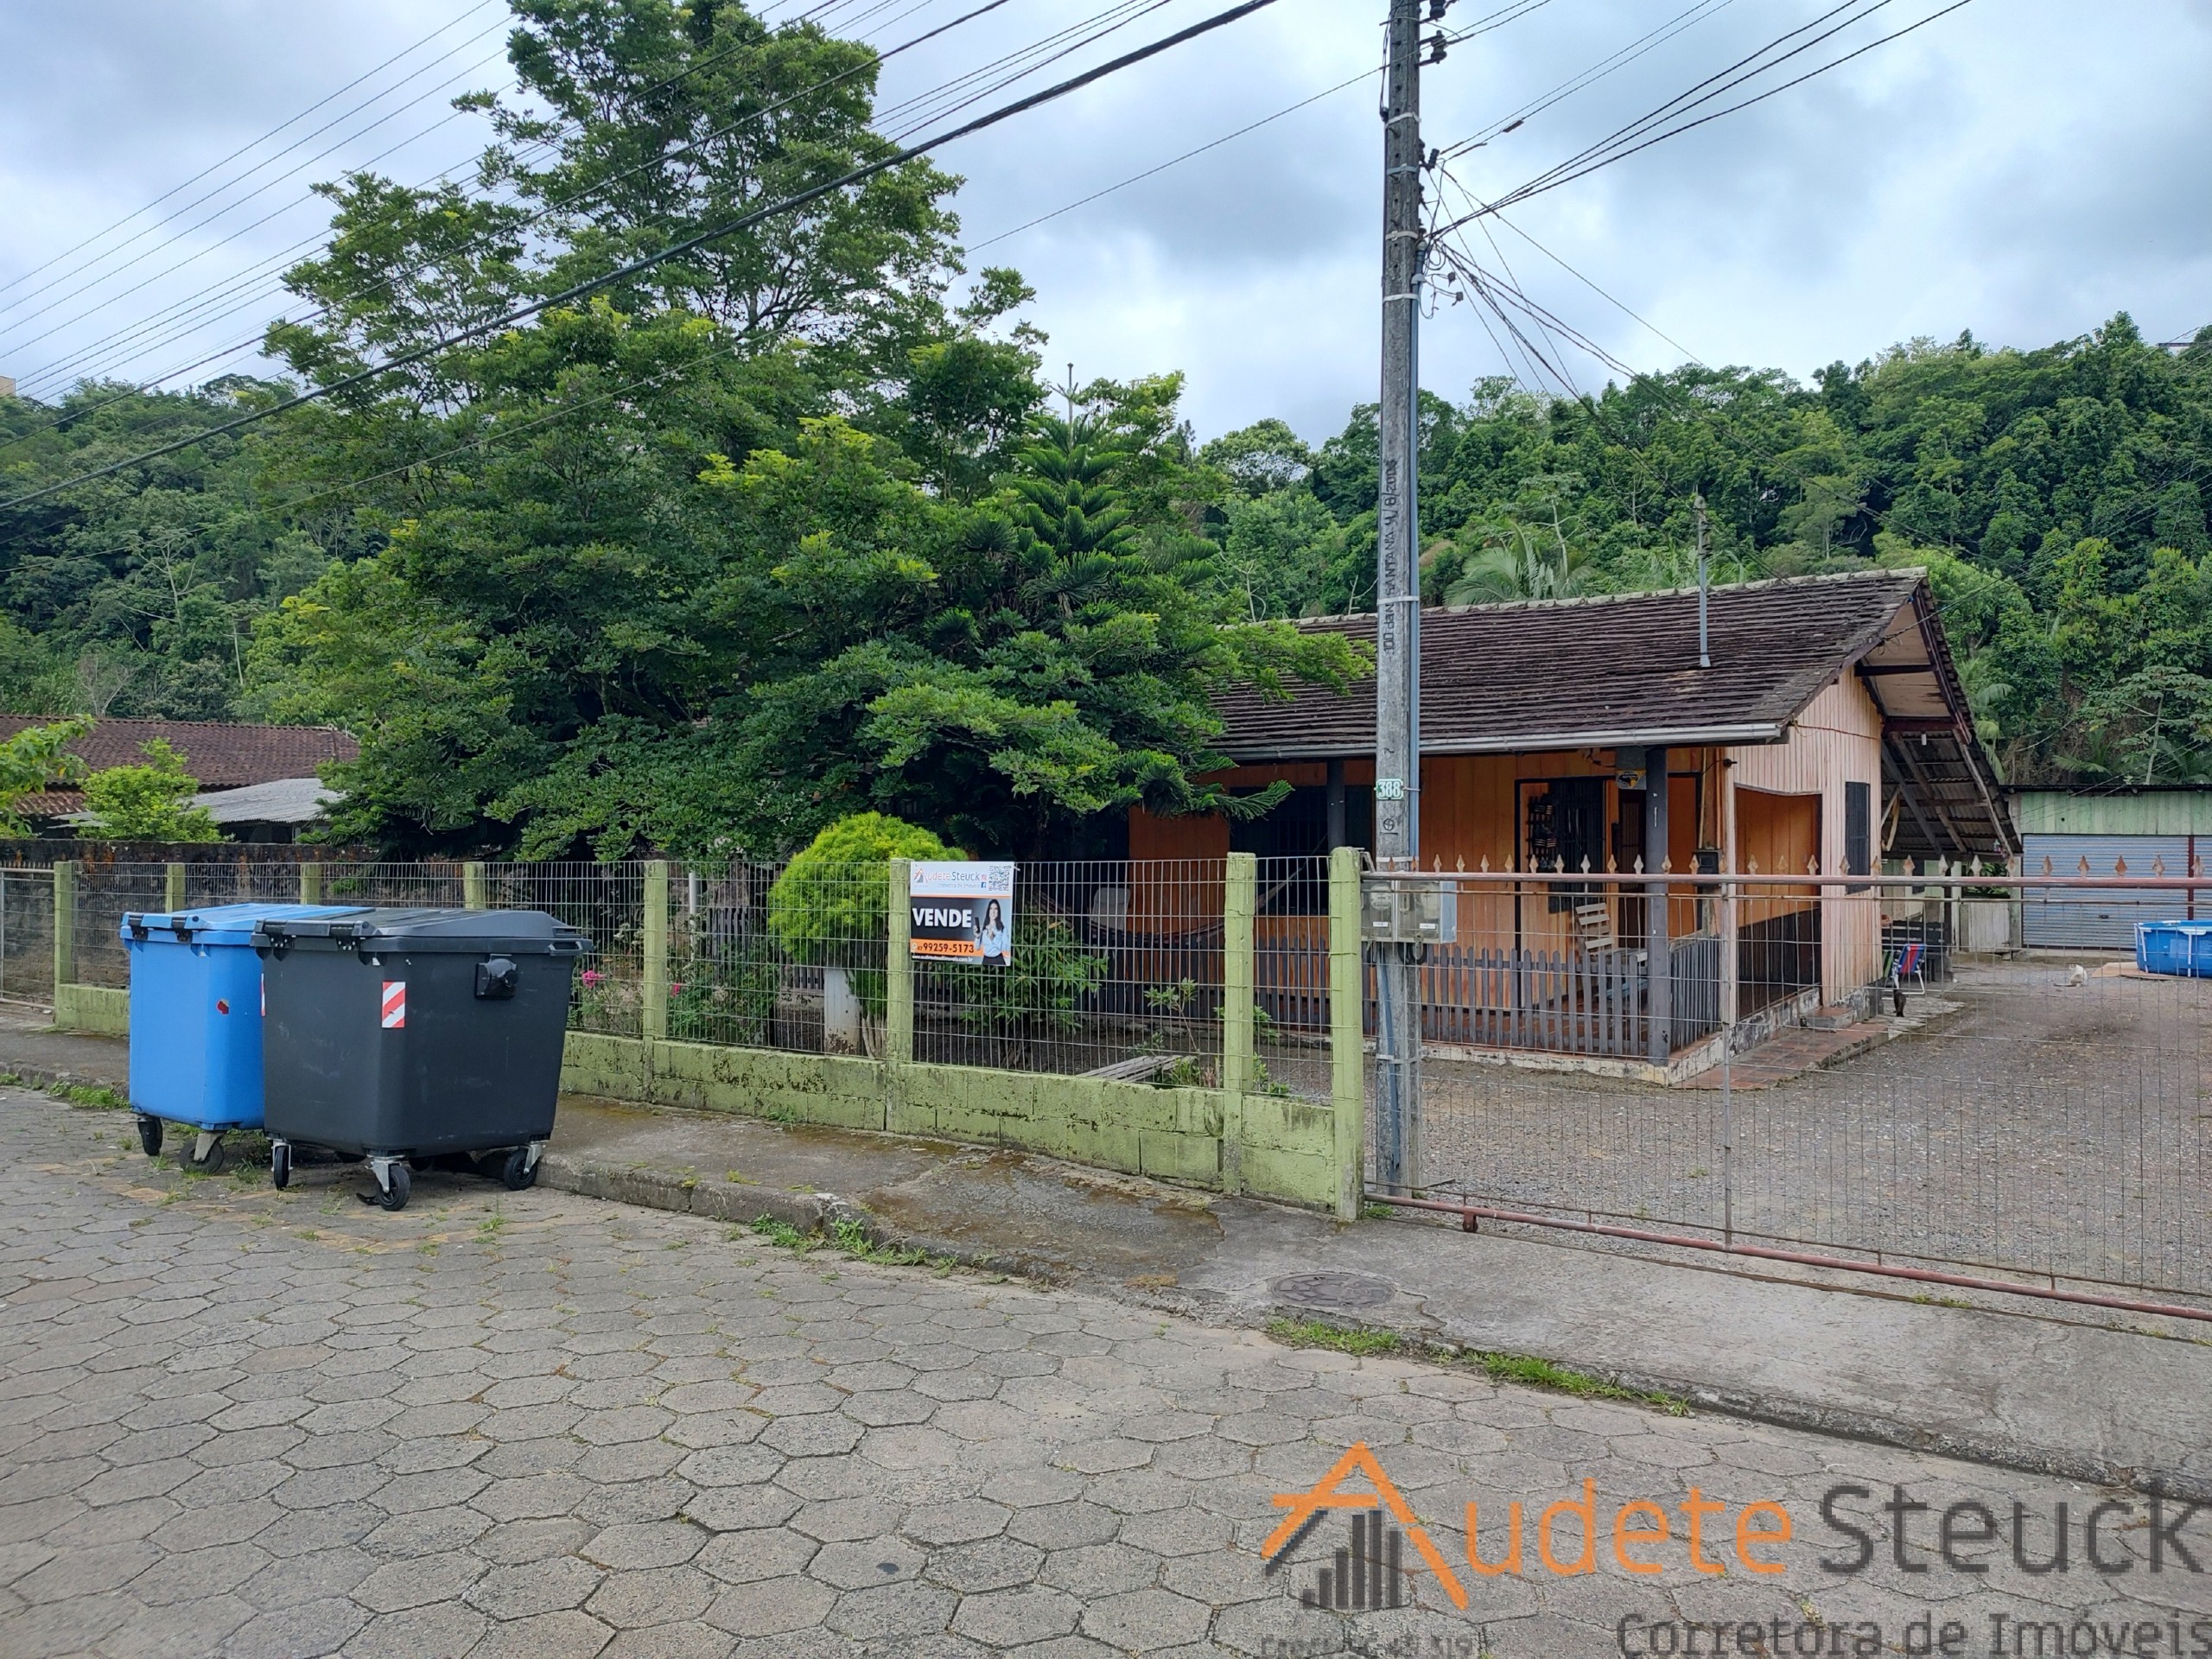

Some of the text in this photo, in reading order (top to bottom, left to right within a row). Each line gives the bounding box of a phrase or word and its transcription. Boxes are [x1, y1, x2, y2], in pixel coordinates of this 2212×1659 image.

[1378, 781, 1401, 798] 388
[912, 908, 972, 928] VENDE
[923, 943, 975, 953] 99259-5173
